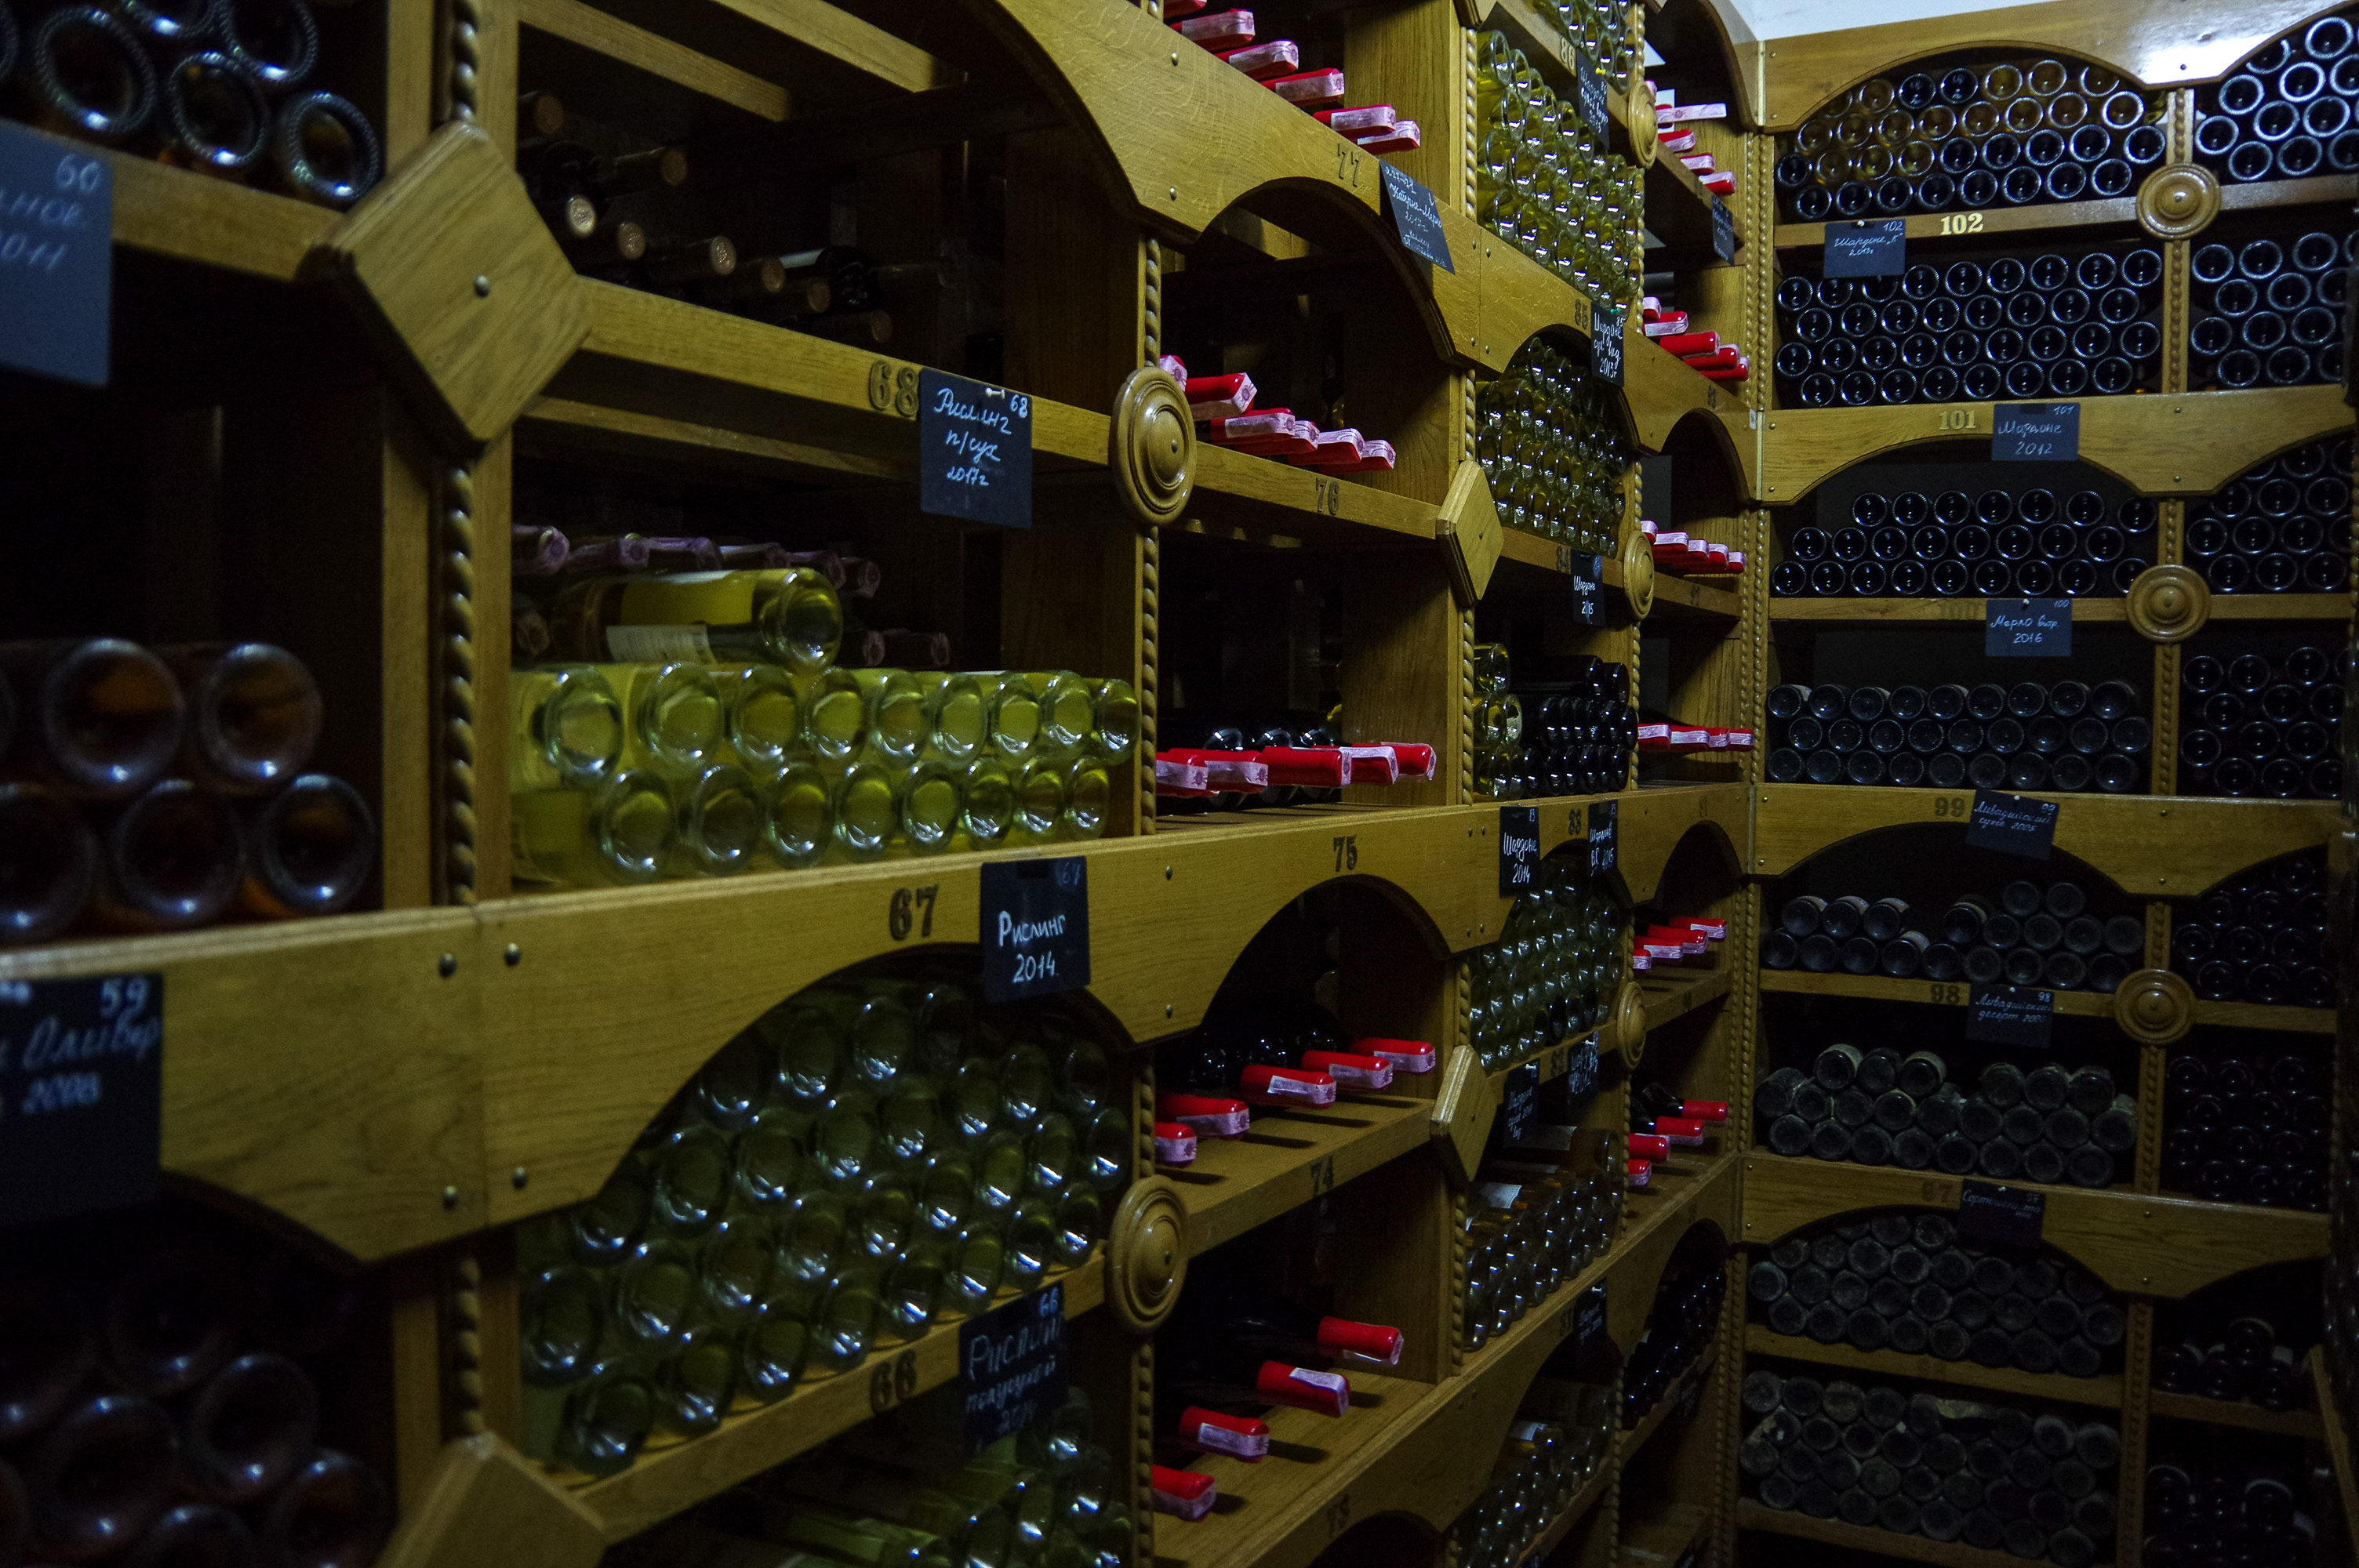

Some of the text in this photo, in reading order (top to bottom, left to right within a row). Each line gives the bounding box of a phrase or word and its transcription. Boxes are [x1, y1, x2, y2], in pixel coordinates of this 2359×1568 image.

[56, 153, 100, 193] 60
[1338, 143, 1359, 187] 77
[1883, 220, 1903, 231] 102
[1940, 212, 1984, 235] 102
[869, 360, 919, 417] 68
[1010, 394, 1028, 419] 68
[2053, 405, 2075, 416] 101
[1939, 409, 1976, 430] 101
[2015, 441, 2053, 456] 2012
[1315, 477, 1339, 515] 76
[1990, 615, 2034, 630] Мерло
[2013, 633, 2044, 644] 2016
[1935, 797, 1965, 817] 99
[1333, 834, 1358, 872] 75
[1512, 863, 1530, 884] 2014
[889, 884, 939, 940] 67
[998, 910, 1066, 947] Рислинг
[1012, 950, 1056, 983] 2014
[100, 978, 149, 1019] 59
[1931, 983, 1960, 1004] 98
[2038, 992, 2051, 1003] 98
[1310, 1154, 1334, 1195] 74
[871, 1349, 916, 1414] 66
